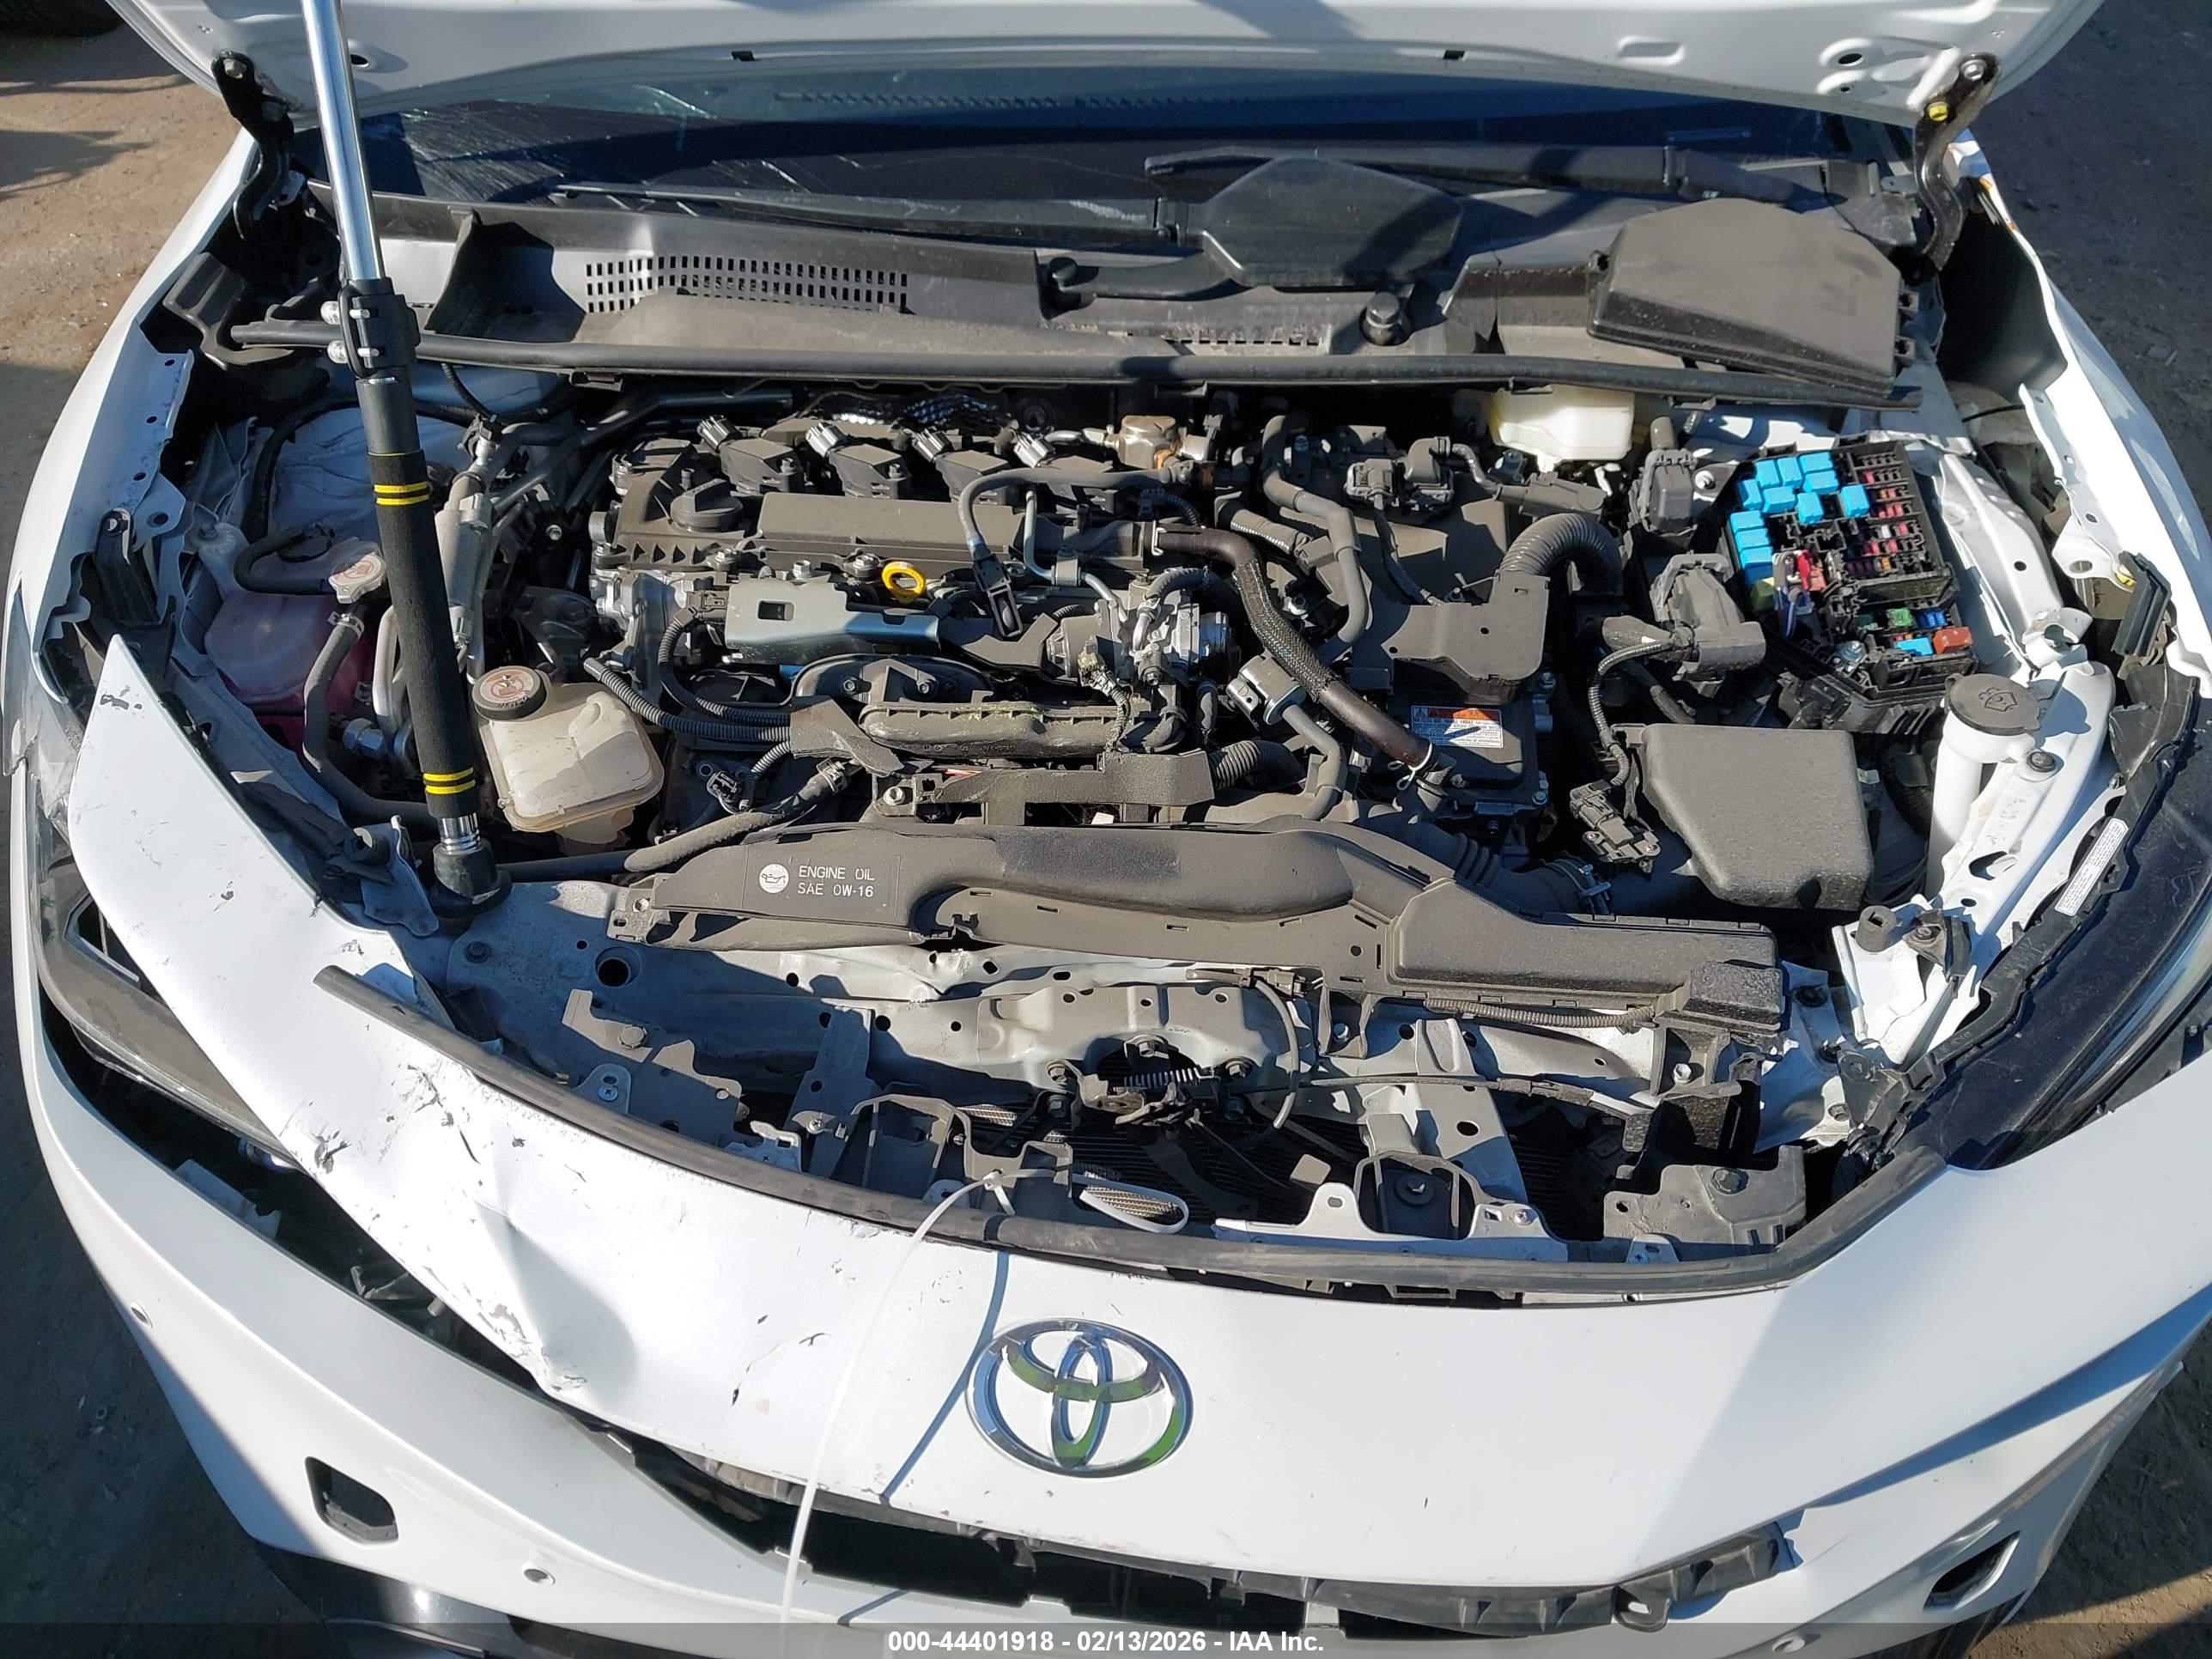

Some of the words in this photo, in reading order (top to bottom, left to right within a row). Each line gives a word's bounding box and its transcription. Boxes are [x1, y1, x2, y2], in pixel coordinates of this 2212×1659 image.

[799, 865, 846, 880] ENGINE
[855, 867, 875, 881] OIL
[798, 882, 824, 896] SAE
[833, 884, 874, 898] 0W-16
